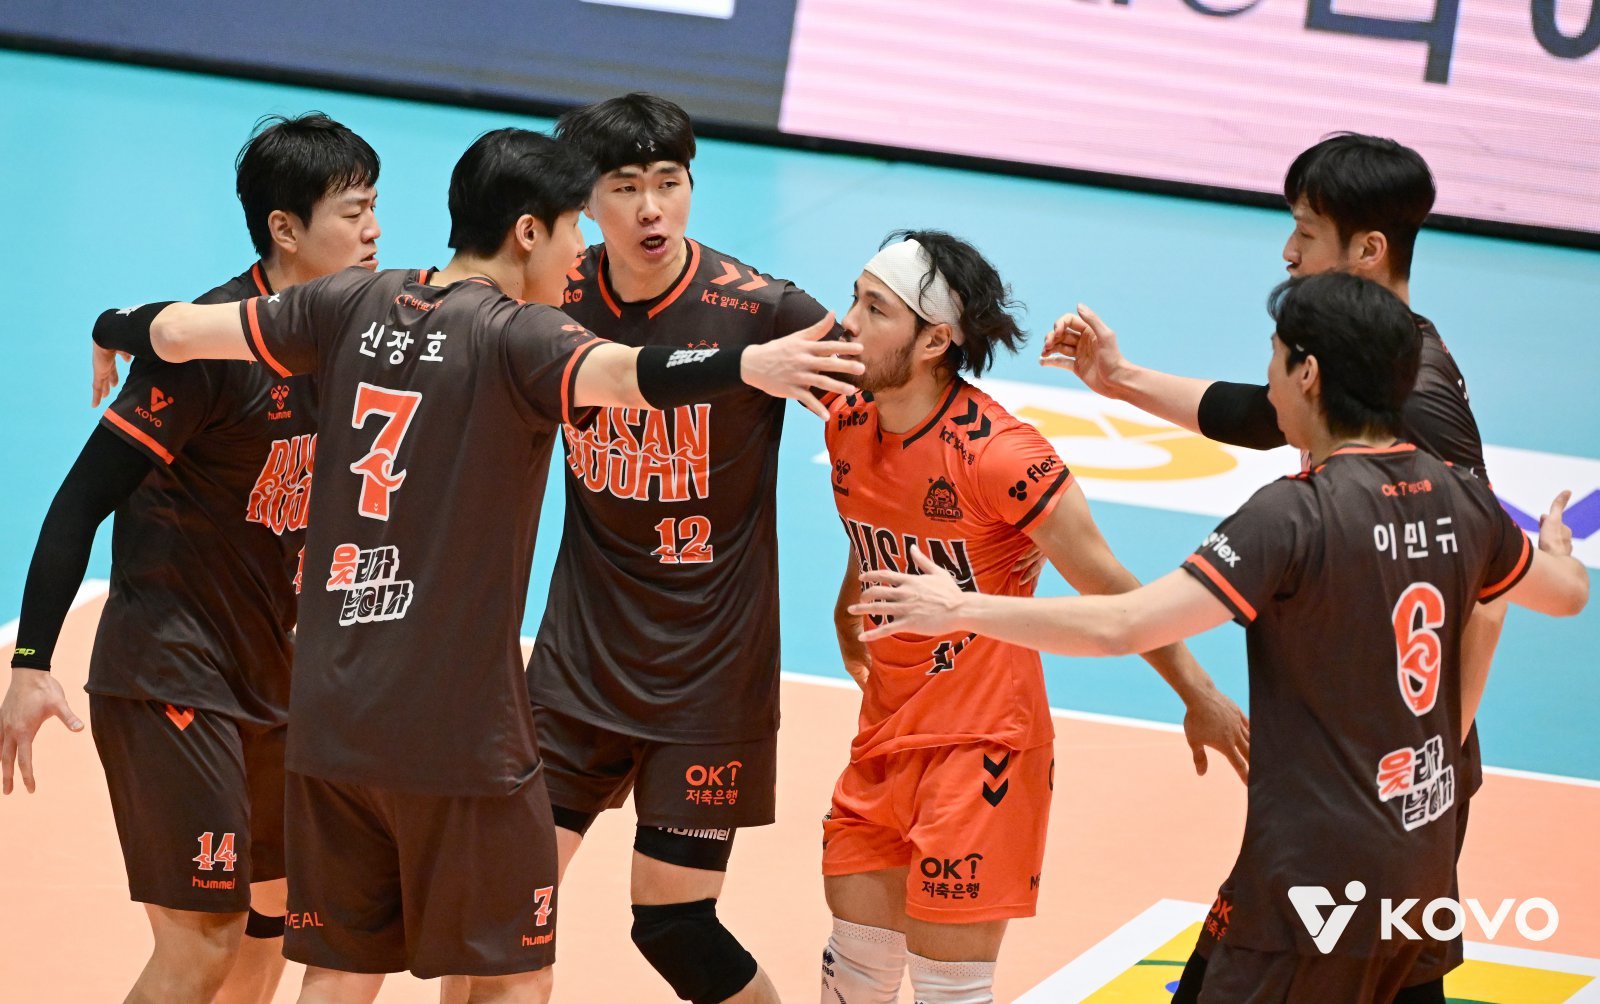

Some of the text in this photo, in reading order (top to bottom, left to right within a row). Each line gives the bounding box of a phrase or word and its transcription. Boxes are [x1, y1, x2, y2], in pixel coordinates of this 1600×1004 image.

[701, 289, 720, 305] kt
[360, 321, 447, 365] 신장호
[135, 406, 162, 428] KOVO
[351, 381, 423, 522] 7
[1026, 455, 1058, 484] flex
[650, 515, 714, 564] 12
[1373, 517, 1459, 560] 이민규
[840, 517, 983, 627] USAN
[1391, 582, 1446, 718] 6
[685, 789, 739, 806] 저축은행
[192, 831, 237, 872] 14
[191, 875, 236, 890] hummel
[922, 881, 980, 900] 저축은행
[533, 885, 554, 927] 7
